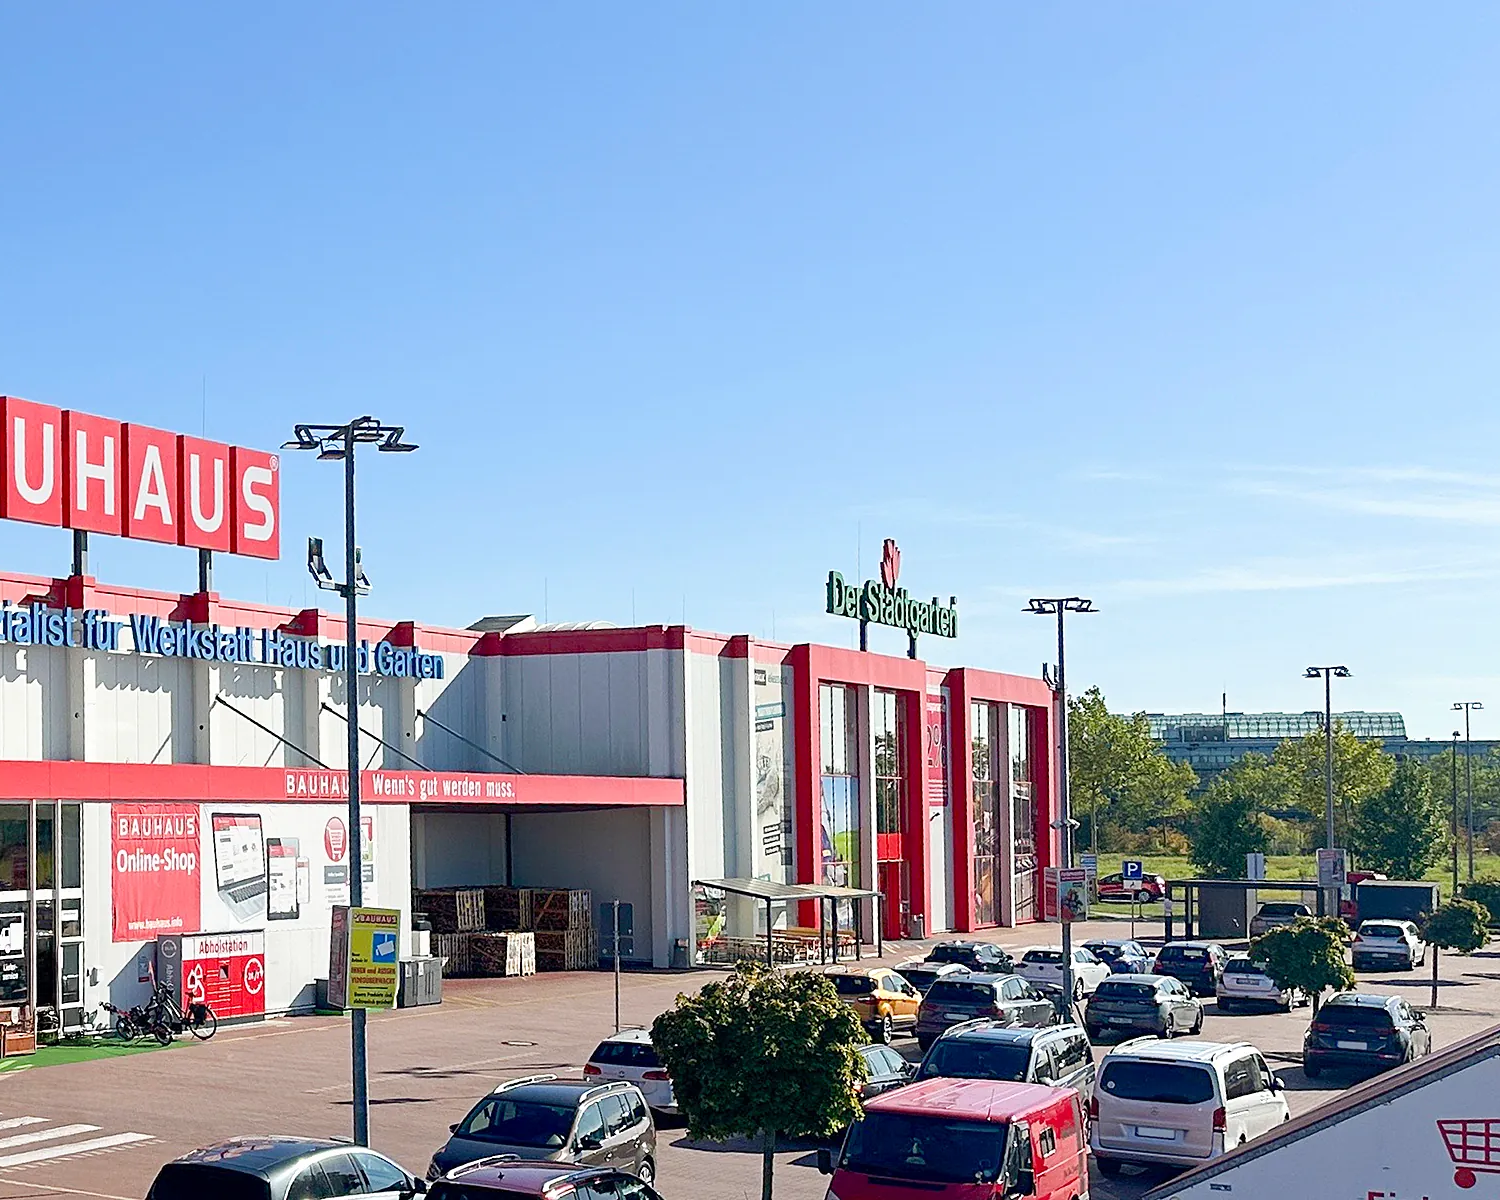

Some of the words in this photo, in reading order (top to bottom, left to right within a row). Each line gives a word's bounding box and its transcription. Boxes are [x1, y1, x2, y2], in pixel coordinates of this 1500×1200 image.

[828, 571, 862, 618] Der
[864, 580, 957, 638] Stadtgarten
[83, 610, 123, 649] für
[130, 613, 256, 661] Werkstatt
[262, 628, 321, 668] Haus
[328, 640, 369, 673] ud
[376, 641, 444, 679] Garten
[286, 774, 349, 797] BAUHAU
[372, 774, 415, 796] Wenn's
[420, 777, 438, 800] gut
[442, 776, 481, 797] werden
[486, 782, 516, 798] muss.
[119, 816, 195, 836] BAUHAUS
[117, 847, 196, 876] Online-Shop
[1128, 863, 1138, 876] P
[128, 916, 183, 930] www.bauhaus.info
[199, 940, 248, 954] Abholstation
